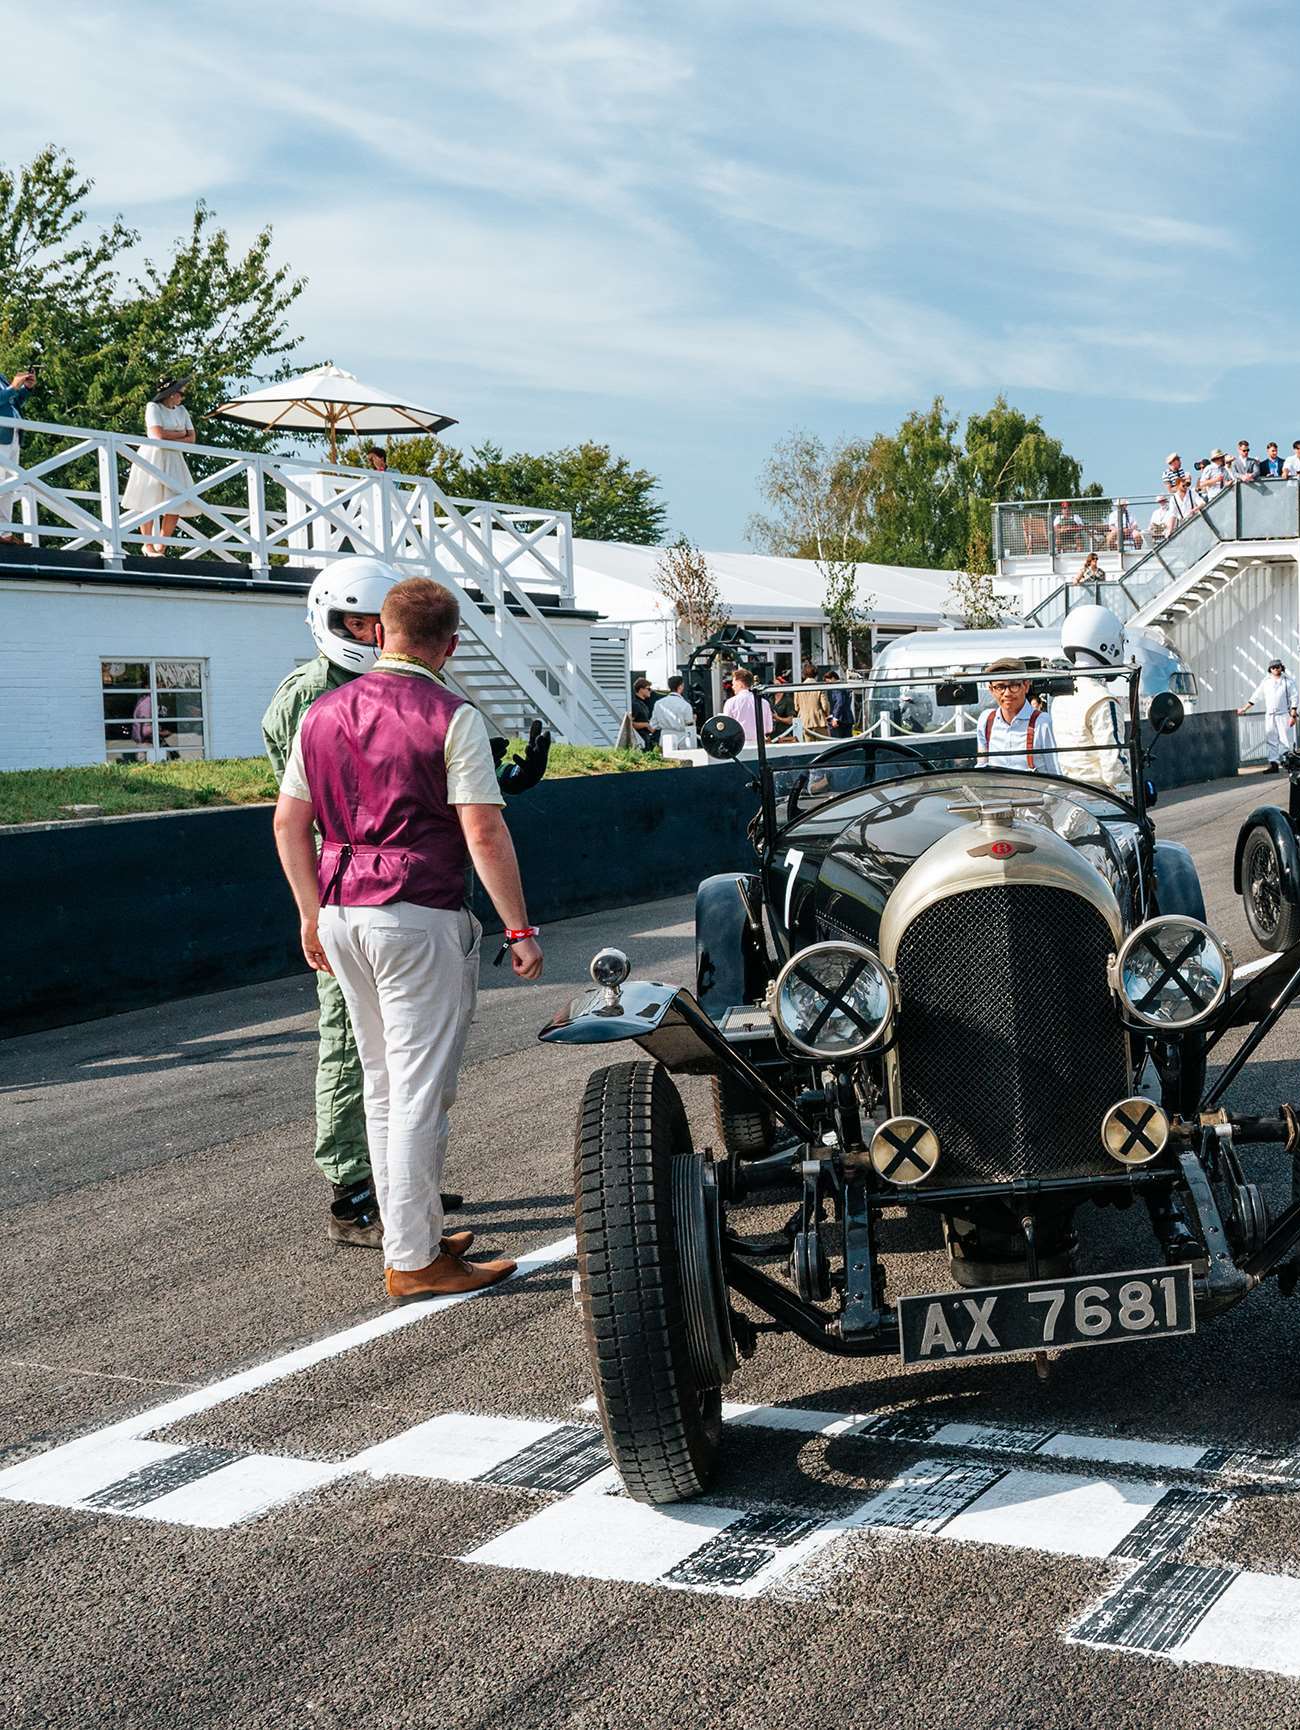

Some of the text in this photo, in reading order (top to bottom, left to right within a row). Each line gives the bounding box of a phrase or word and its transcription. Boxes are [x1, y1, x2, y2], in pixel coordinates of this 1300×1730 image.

[784, 848, 804, 929] 7
[920, 1276, 1177, 1355] AX 7681
